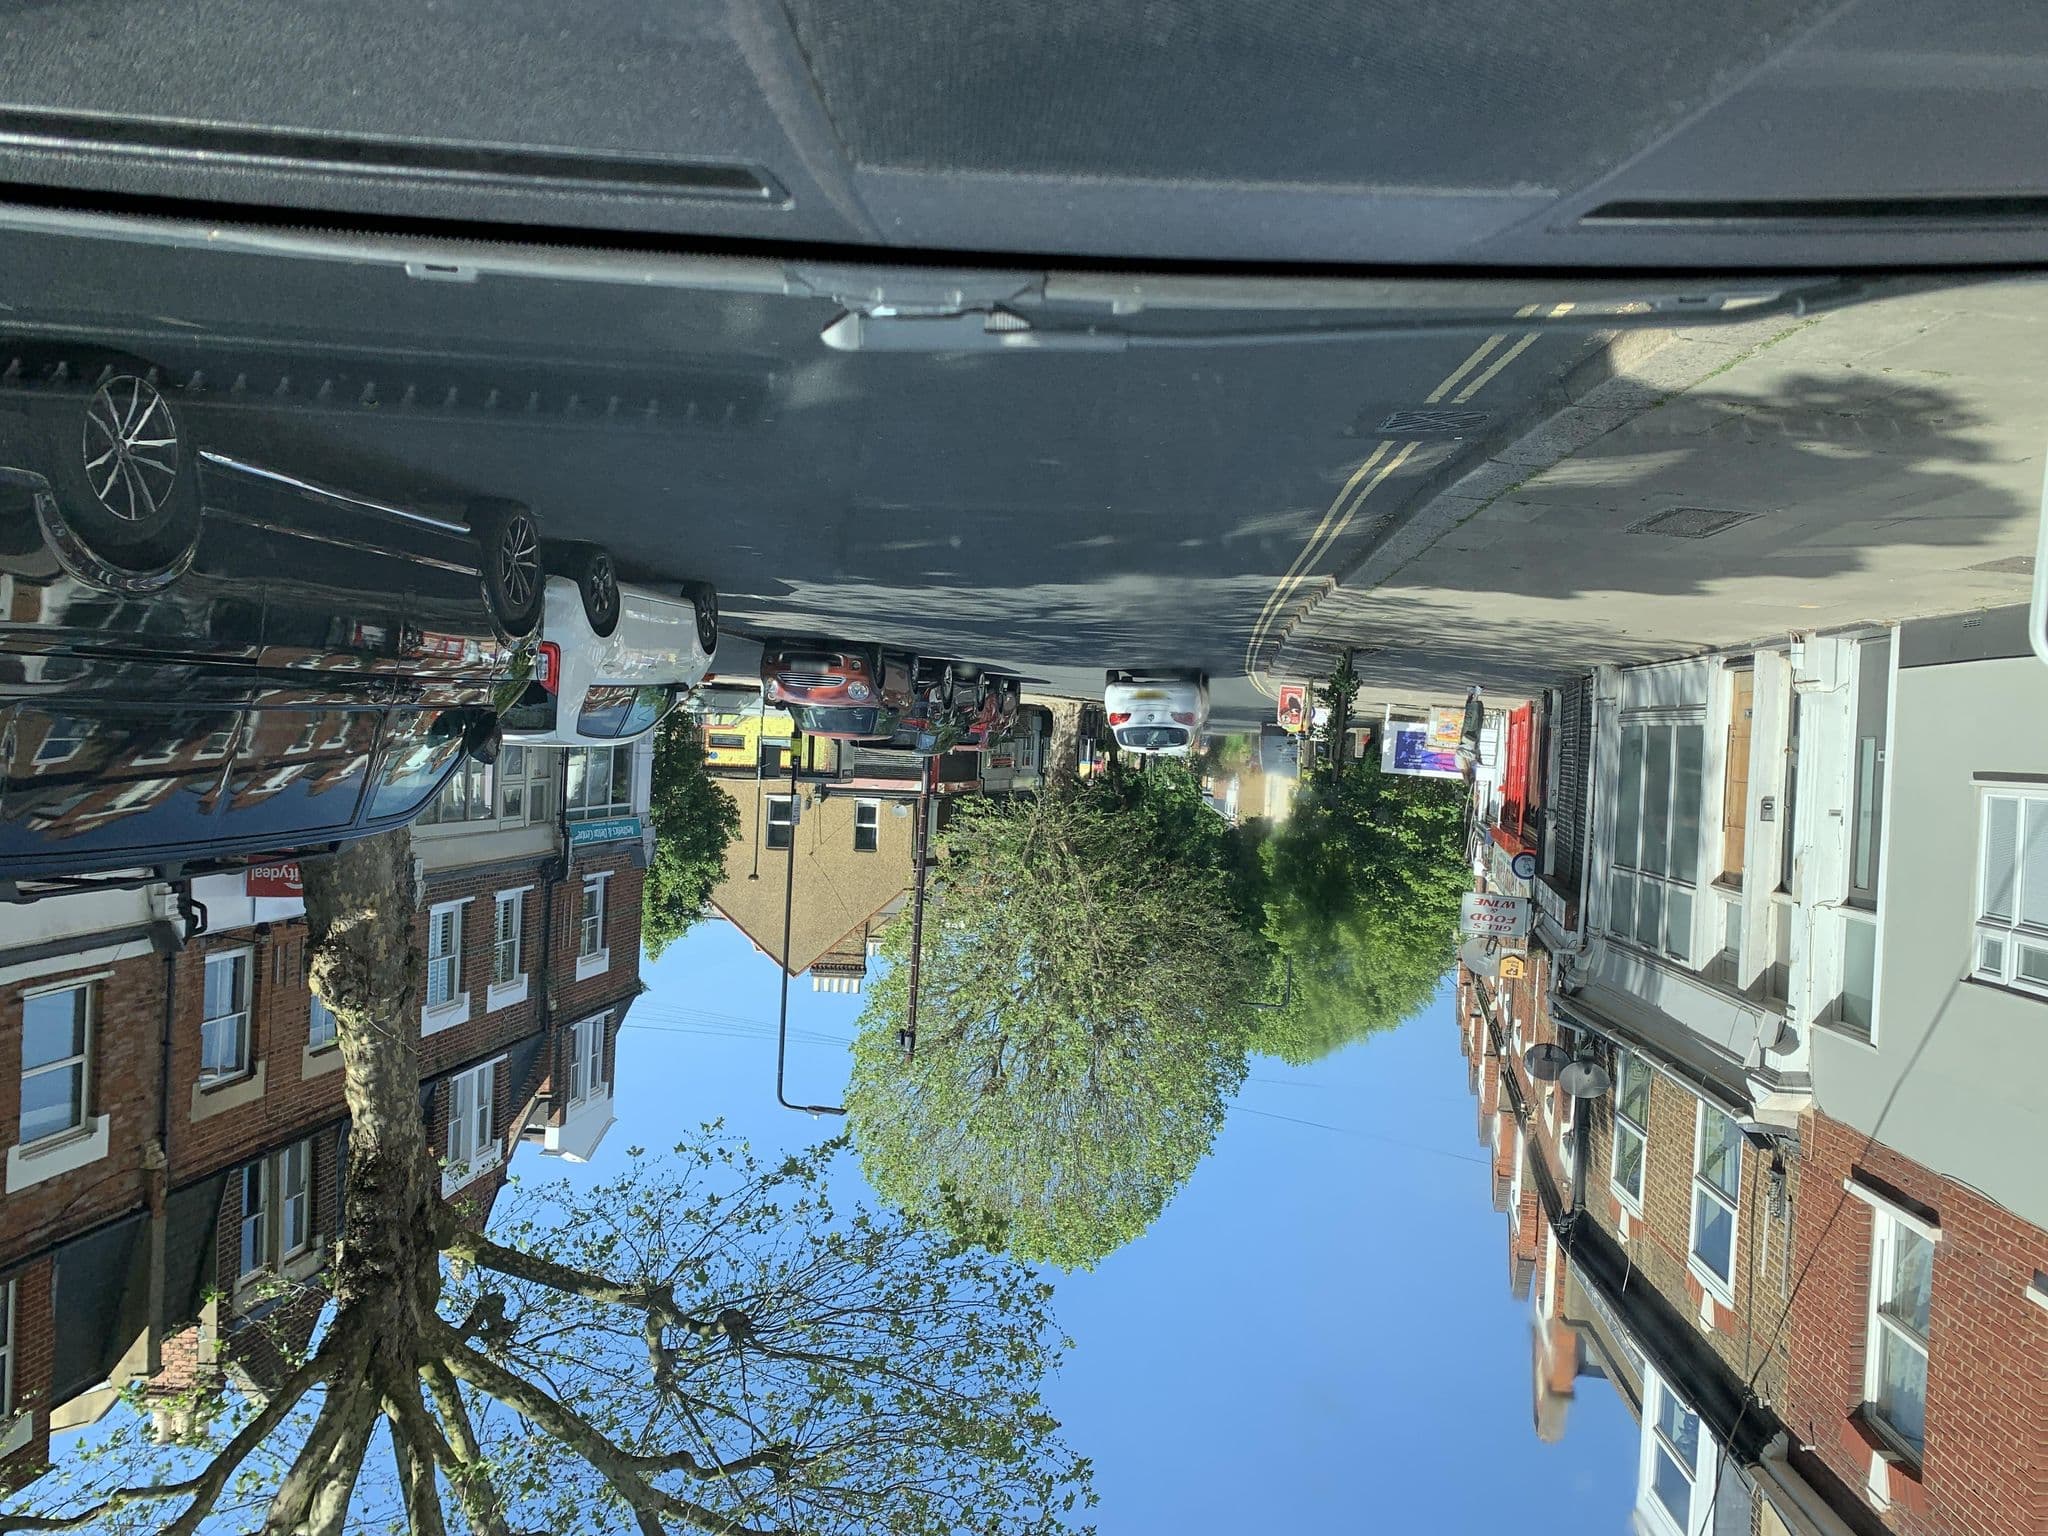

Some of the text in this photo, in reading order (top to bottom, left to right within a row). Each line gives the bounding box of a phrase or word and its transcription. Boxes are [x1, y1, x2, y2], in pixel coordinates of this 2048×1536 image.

[575, 830, 593, 841] Centre
[251, 865, 301, 884] itydeal
[1473, 898, 1516, 909] WINE
[1470, 913, 1517, 924] FOOD
[1472, 923, 1511, 932] GILL'S
